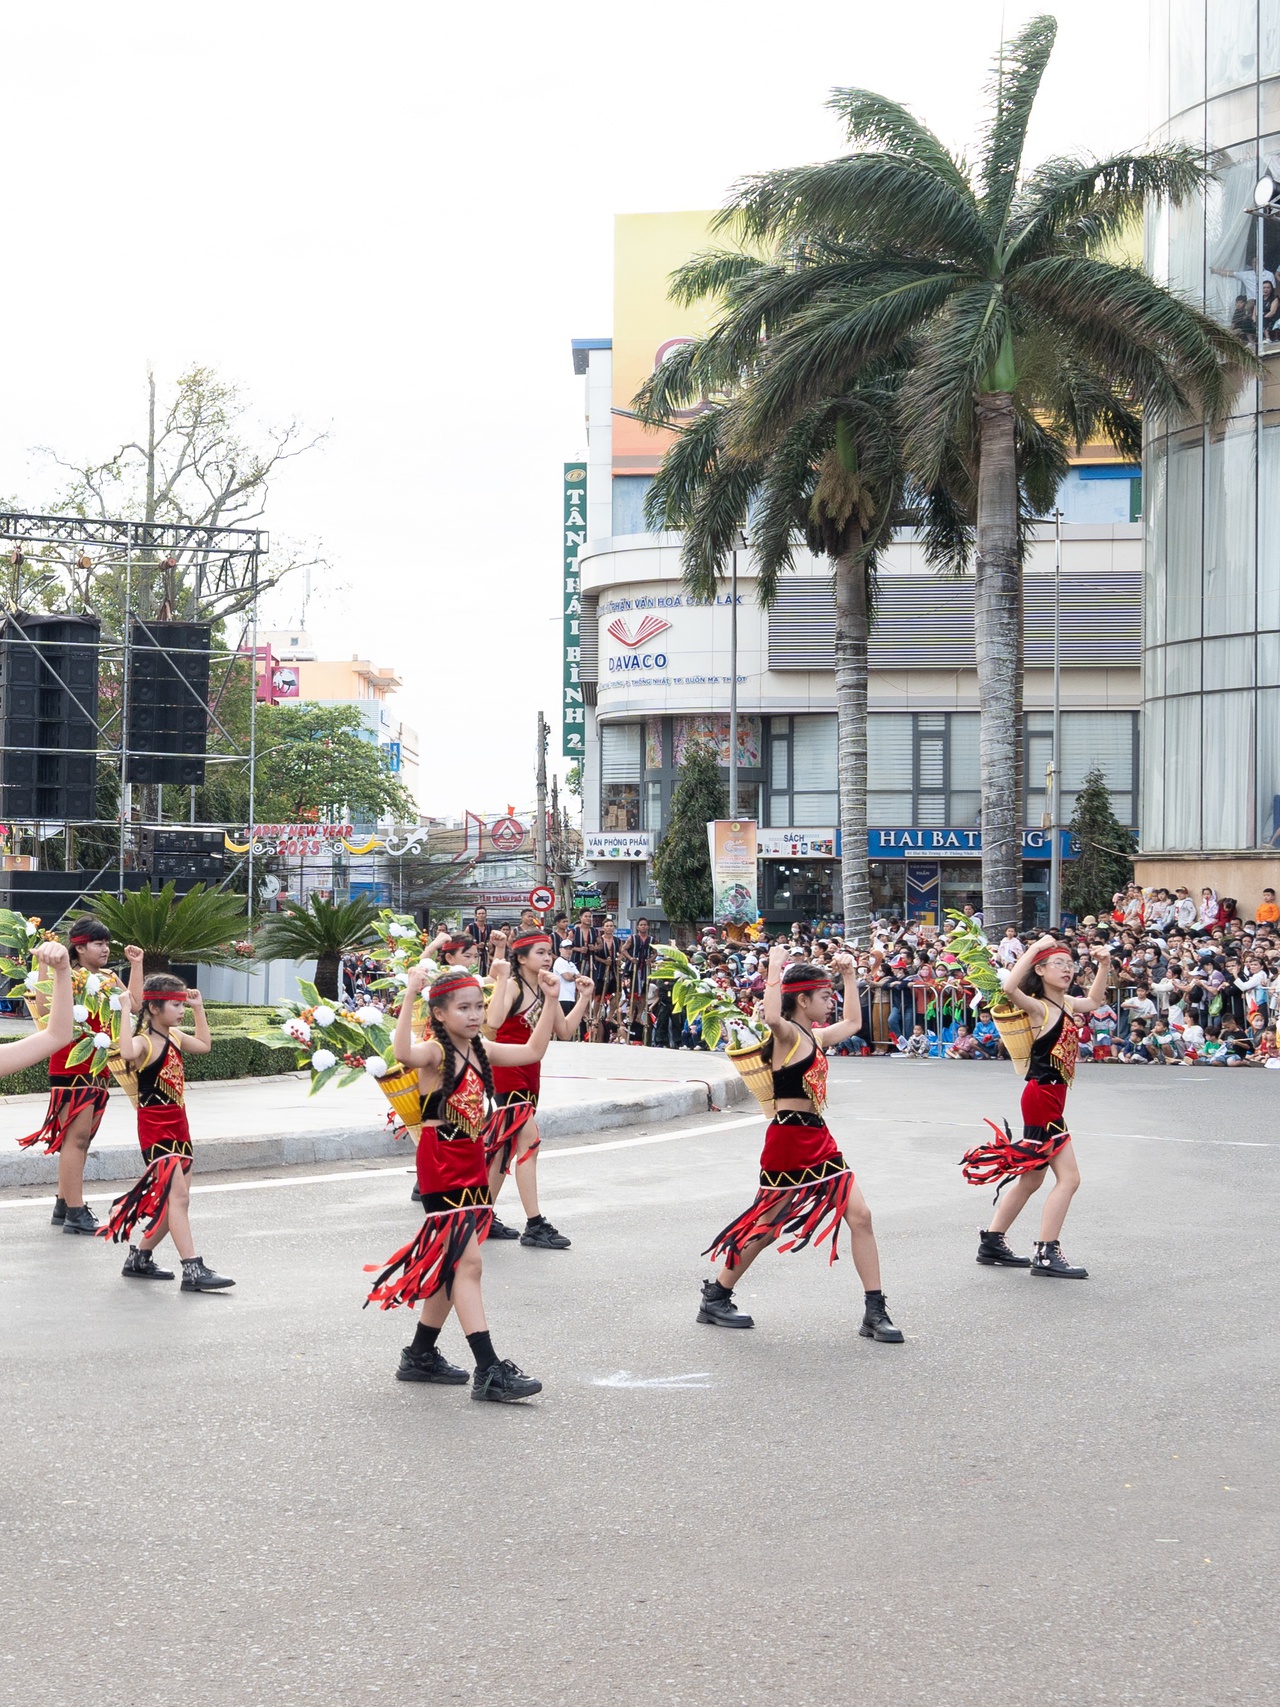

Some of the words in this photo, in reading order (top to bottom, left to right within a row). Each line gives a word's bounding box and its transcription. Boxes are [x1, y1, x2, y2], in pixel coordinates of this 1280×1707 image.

[565, 489, 586, 546] TÂN
[634, 596, 654, 608] VĂN
[608, 653, 667, 672] DAVACO
[565, 646, 584, 724] BÌNH
[685, 676, 705, 684] BUÔN
[722, 676, 748, 684] THỘT
[567, 733, 582, 748] 2
[287, 824, 318, 837] NEW
[322, 823, 354, 837] YEAR
[783, 832, 805, 843] SÁCH
[588, 837, 603, 847] VĂN
[604, 836, 628, 847] PHÒNG
[879, 831, 924, 848] HAI
[932, 831, 960, 848] BA
[277, 839, 321, 856] 2025
